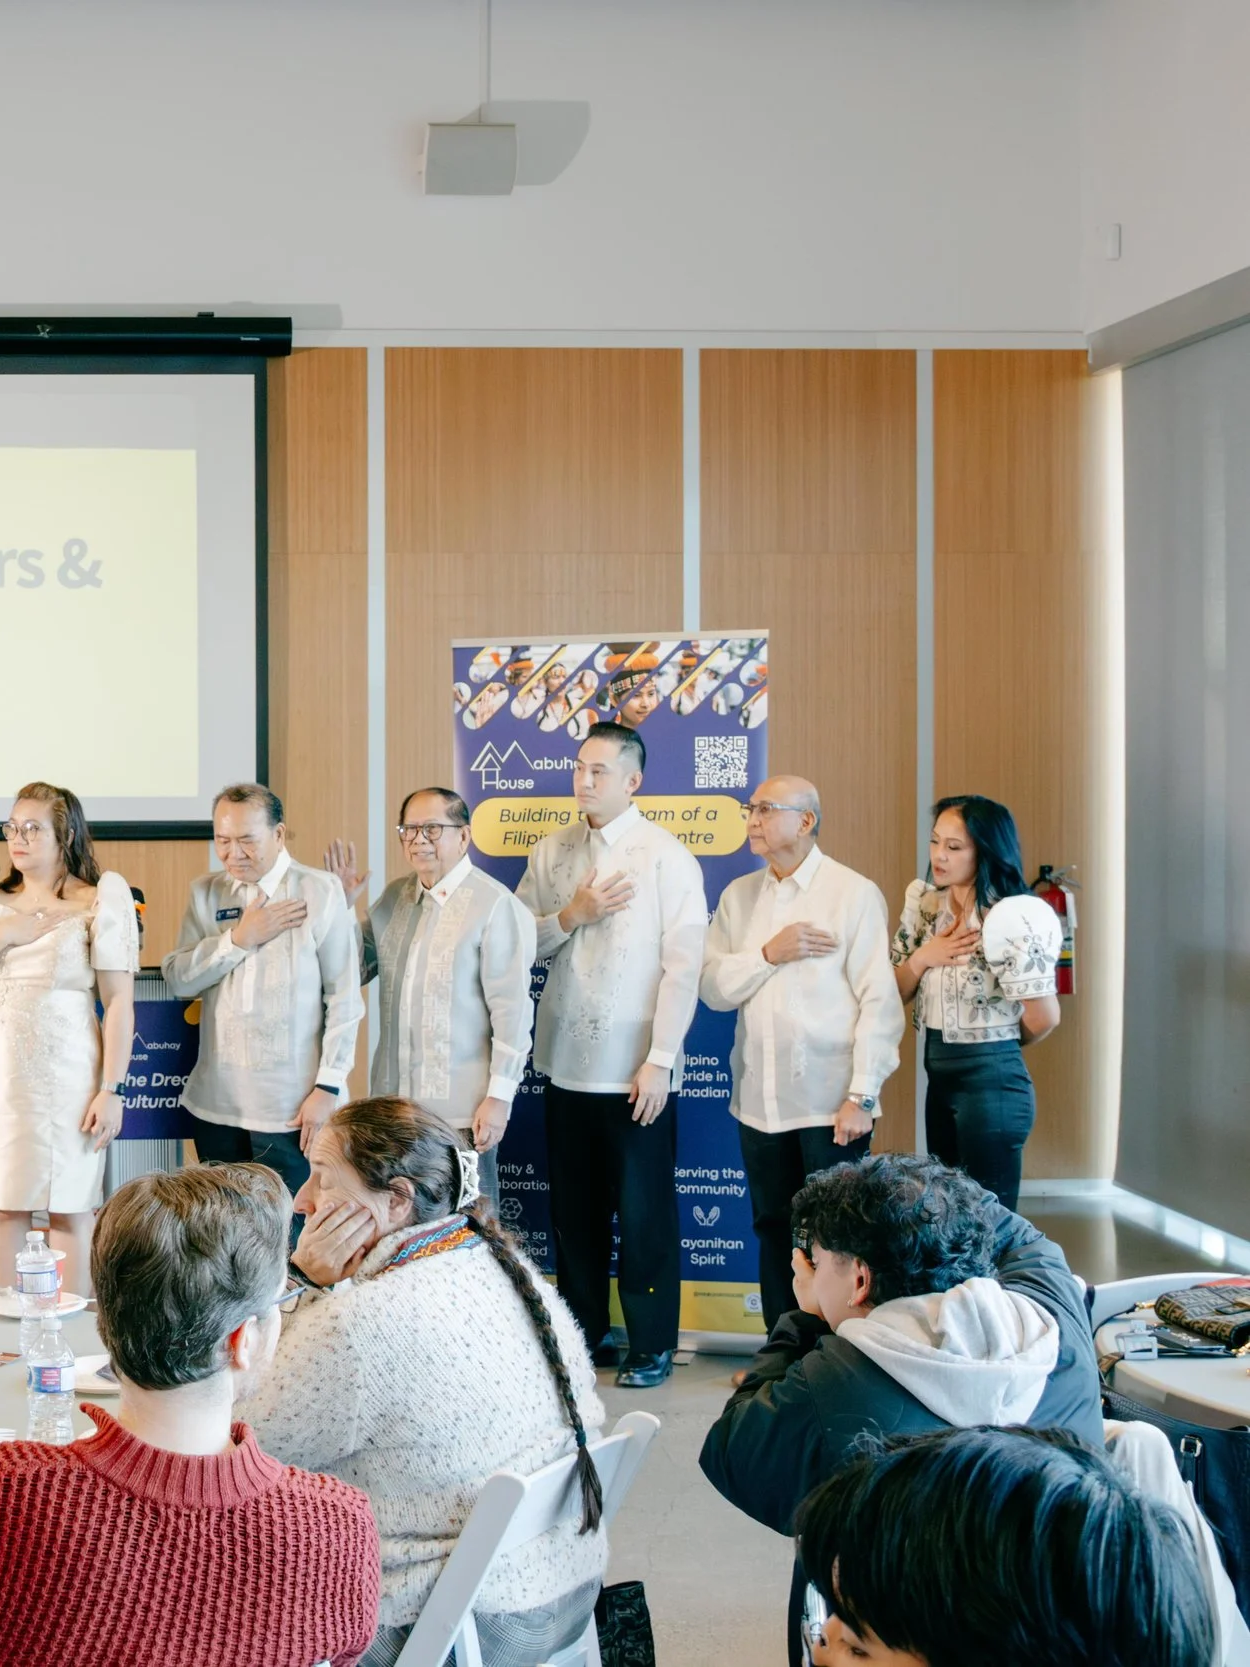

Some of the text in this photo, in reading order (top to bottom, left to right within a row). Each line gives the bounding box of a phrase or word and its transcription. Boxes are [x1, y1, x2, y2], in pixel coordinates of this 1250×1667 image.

[56, 537, 103, 590] &
[499, 808, 571, 826] Building
[681, 806, 701, 821] of
[705, 809, 718, 821] a
[684, 1054, 720, 1069] lipino
[125, 1072, 148, 1087] he
[716, 1071, 729, 1082] in
[525, 1163, 535, 1175] &
[722, 1167, 745, 1180] the
[676, 1183, 747, 1198] ommunity
[680, 1237, 744, 1250] ayanihan
[690, 1253, 726, 1267] Spirit
